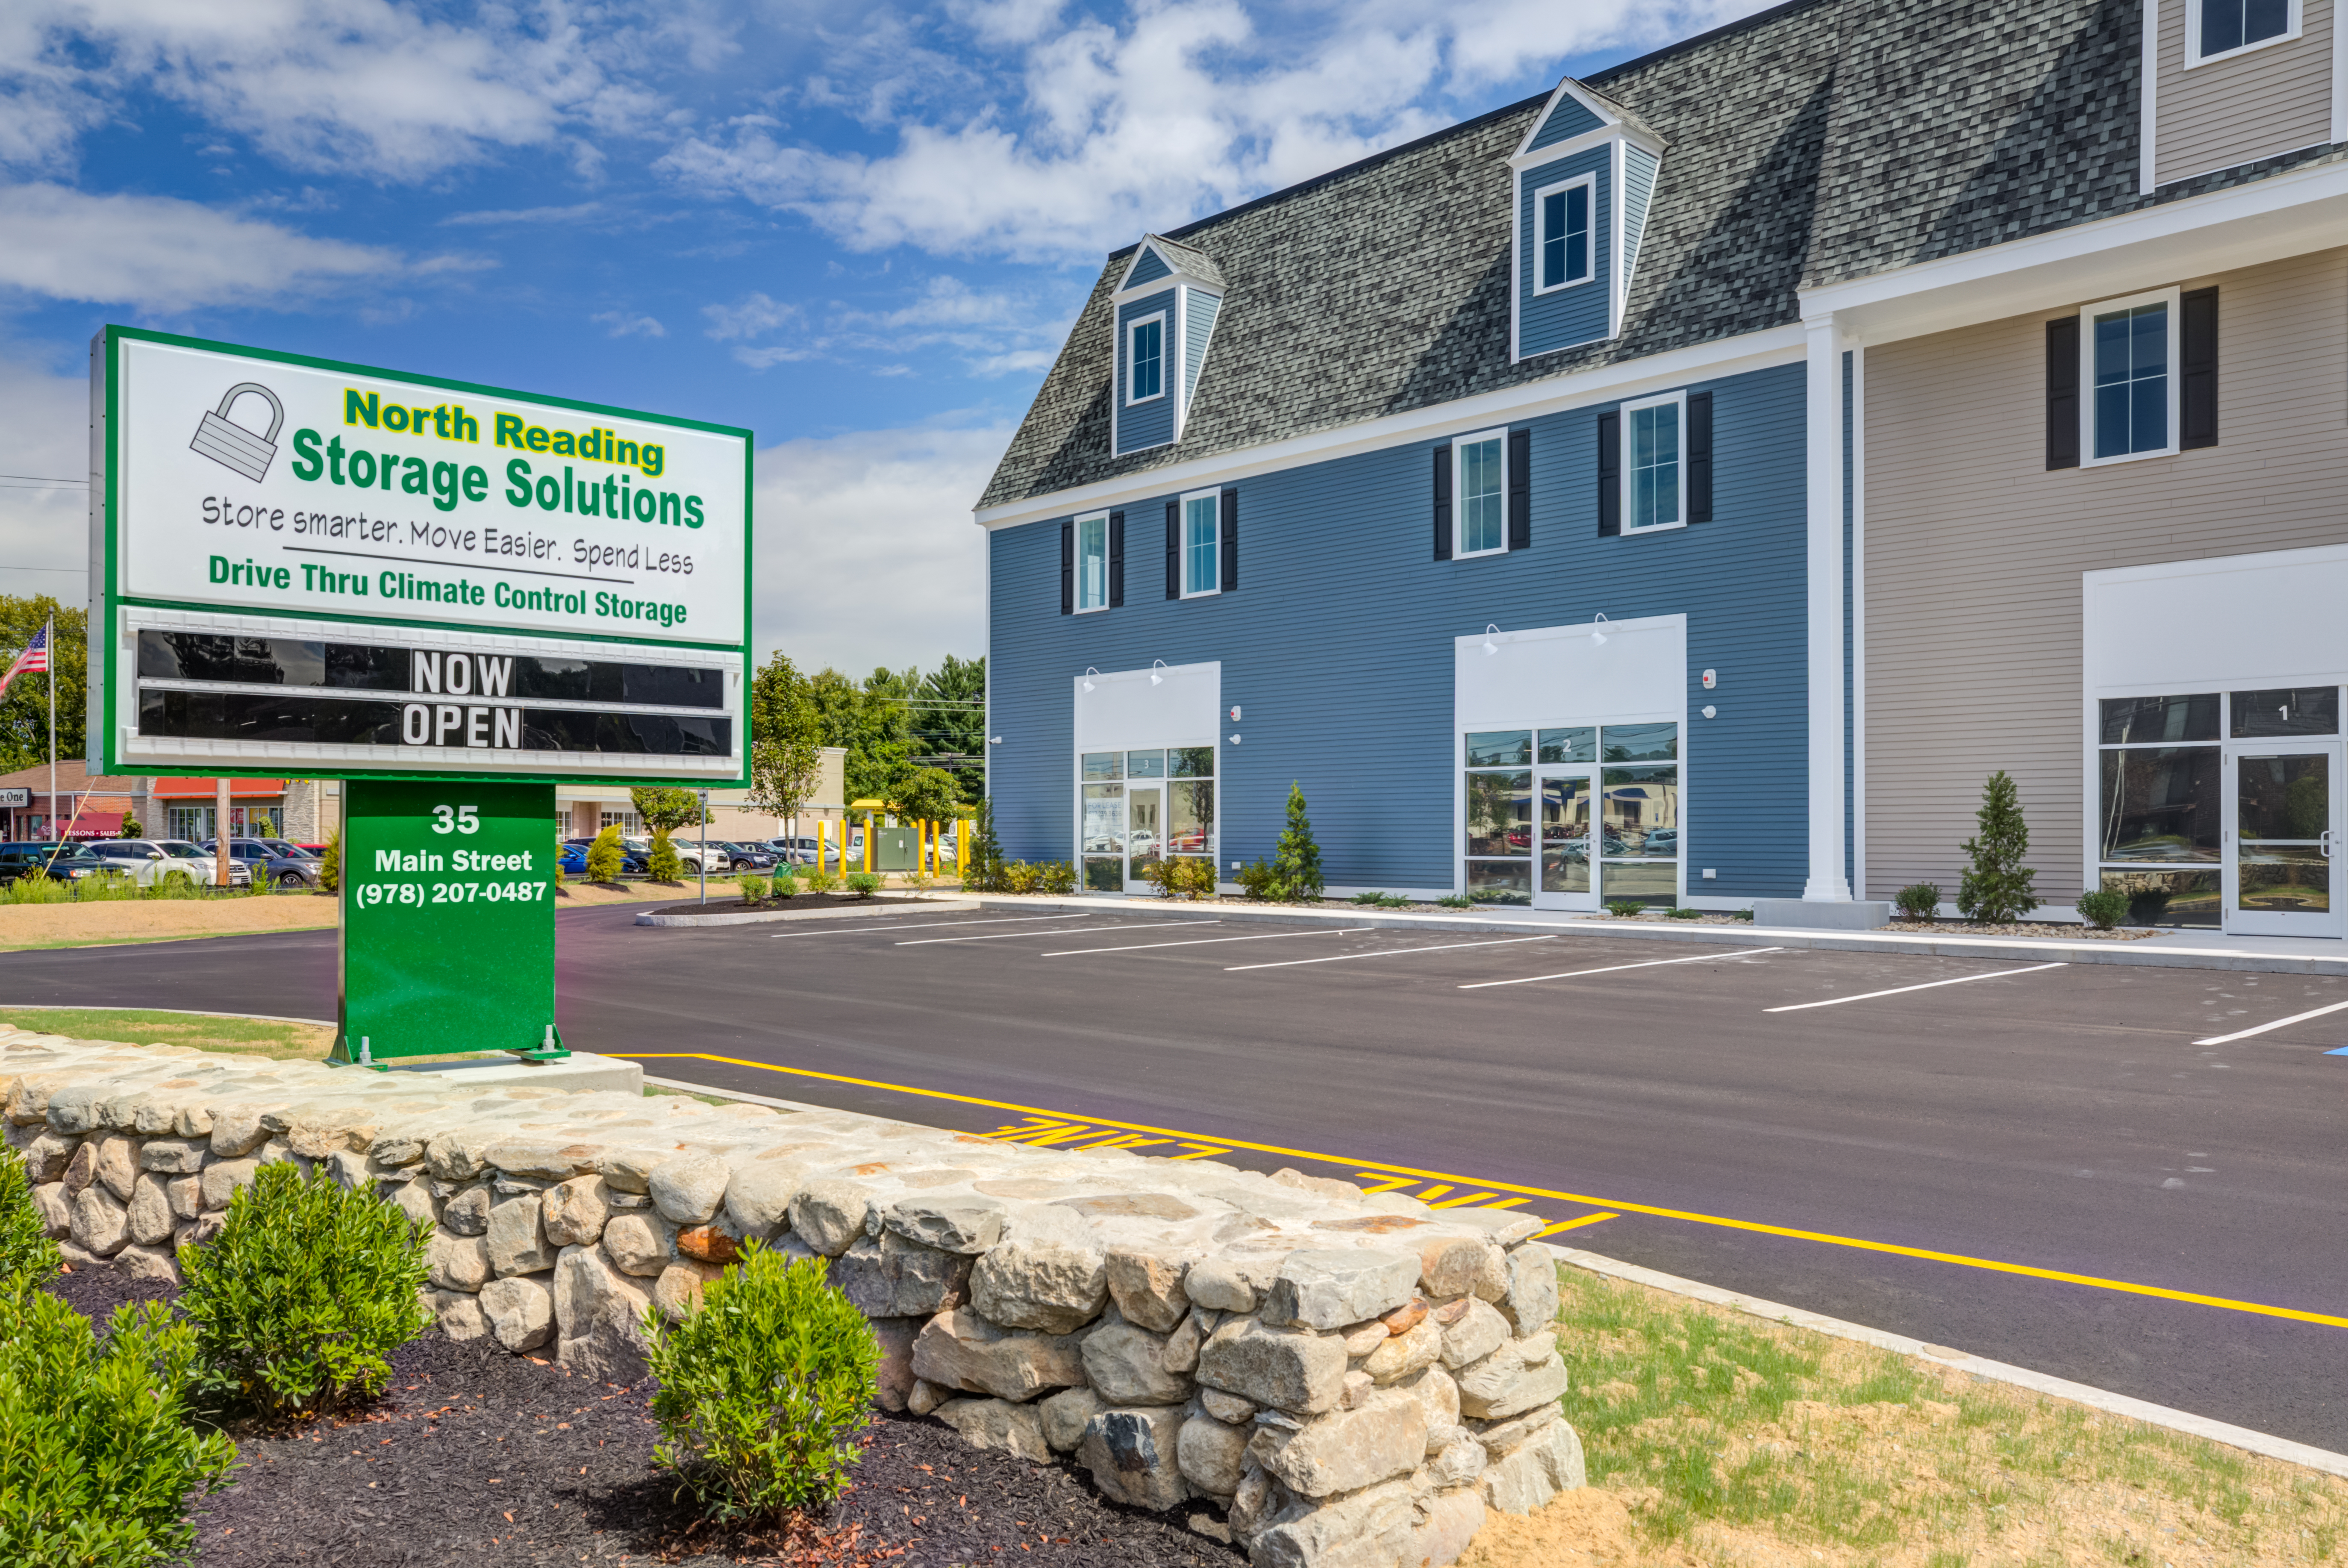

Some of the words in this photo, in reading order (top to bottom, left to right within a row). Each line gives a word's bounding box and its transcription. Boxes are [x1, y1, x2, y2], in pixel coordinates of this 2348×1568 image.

[343, 387, 480, 444] North
[494, 411, 665, 479] Reading
[291, 428, 489, 512] Storage
[505, 458, 704, 529] Solutions
[203, 496, 284, 531] Store
[294, 512, 403, 545] smarter.
[411, 521, 476, 558] Move
[485, 528, 562, 561] Easier.
[574, 539, 638, 572] Spend
[646, 547, 693, 574] Less
[209, 555, 291, 589] Drive
[300, 563, 368, 596] Thru
[379, 571, 485, 606] Climate
[494, 582, 586, 614] Control
[595, 591, 688, 628] Storage
[415, 651, 512, 697] NOW
[403, 703, 519, 748] OPEN
[2278, 705, 2288, 720] 1
[1562, 739, 1571, 752] 2
[1144, 759, 1149, 769] 3
[6, 791, 24, 802] One
[431, 805, 480, 834] 35
[375, 849, 443, 872] Main
[451, 850, 533, 871] Street
[356, 883, 425, 909] (978)
[432, 882, 547, 903] 207-0487
